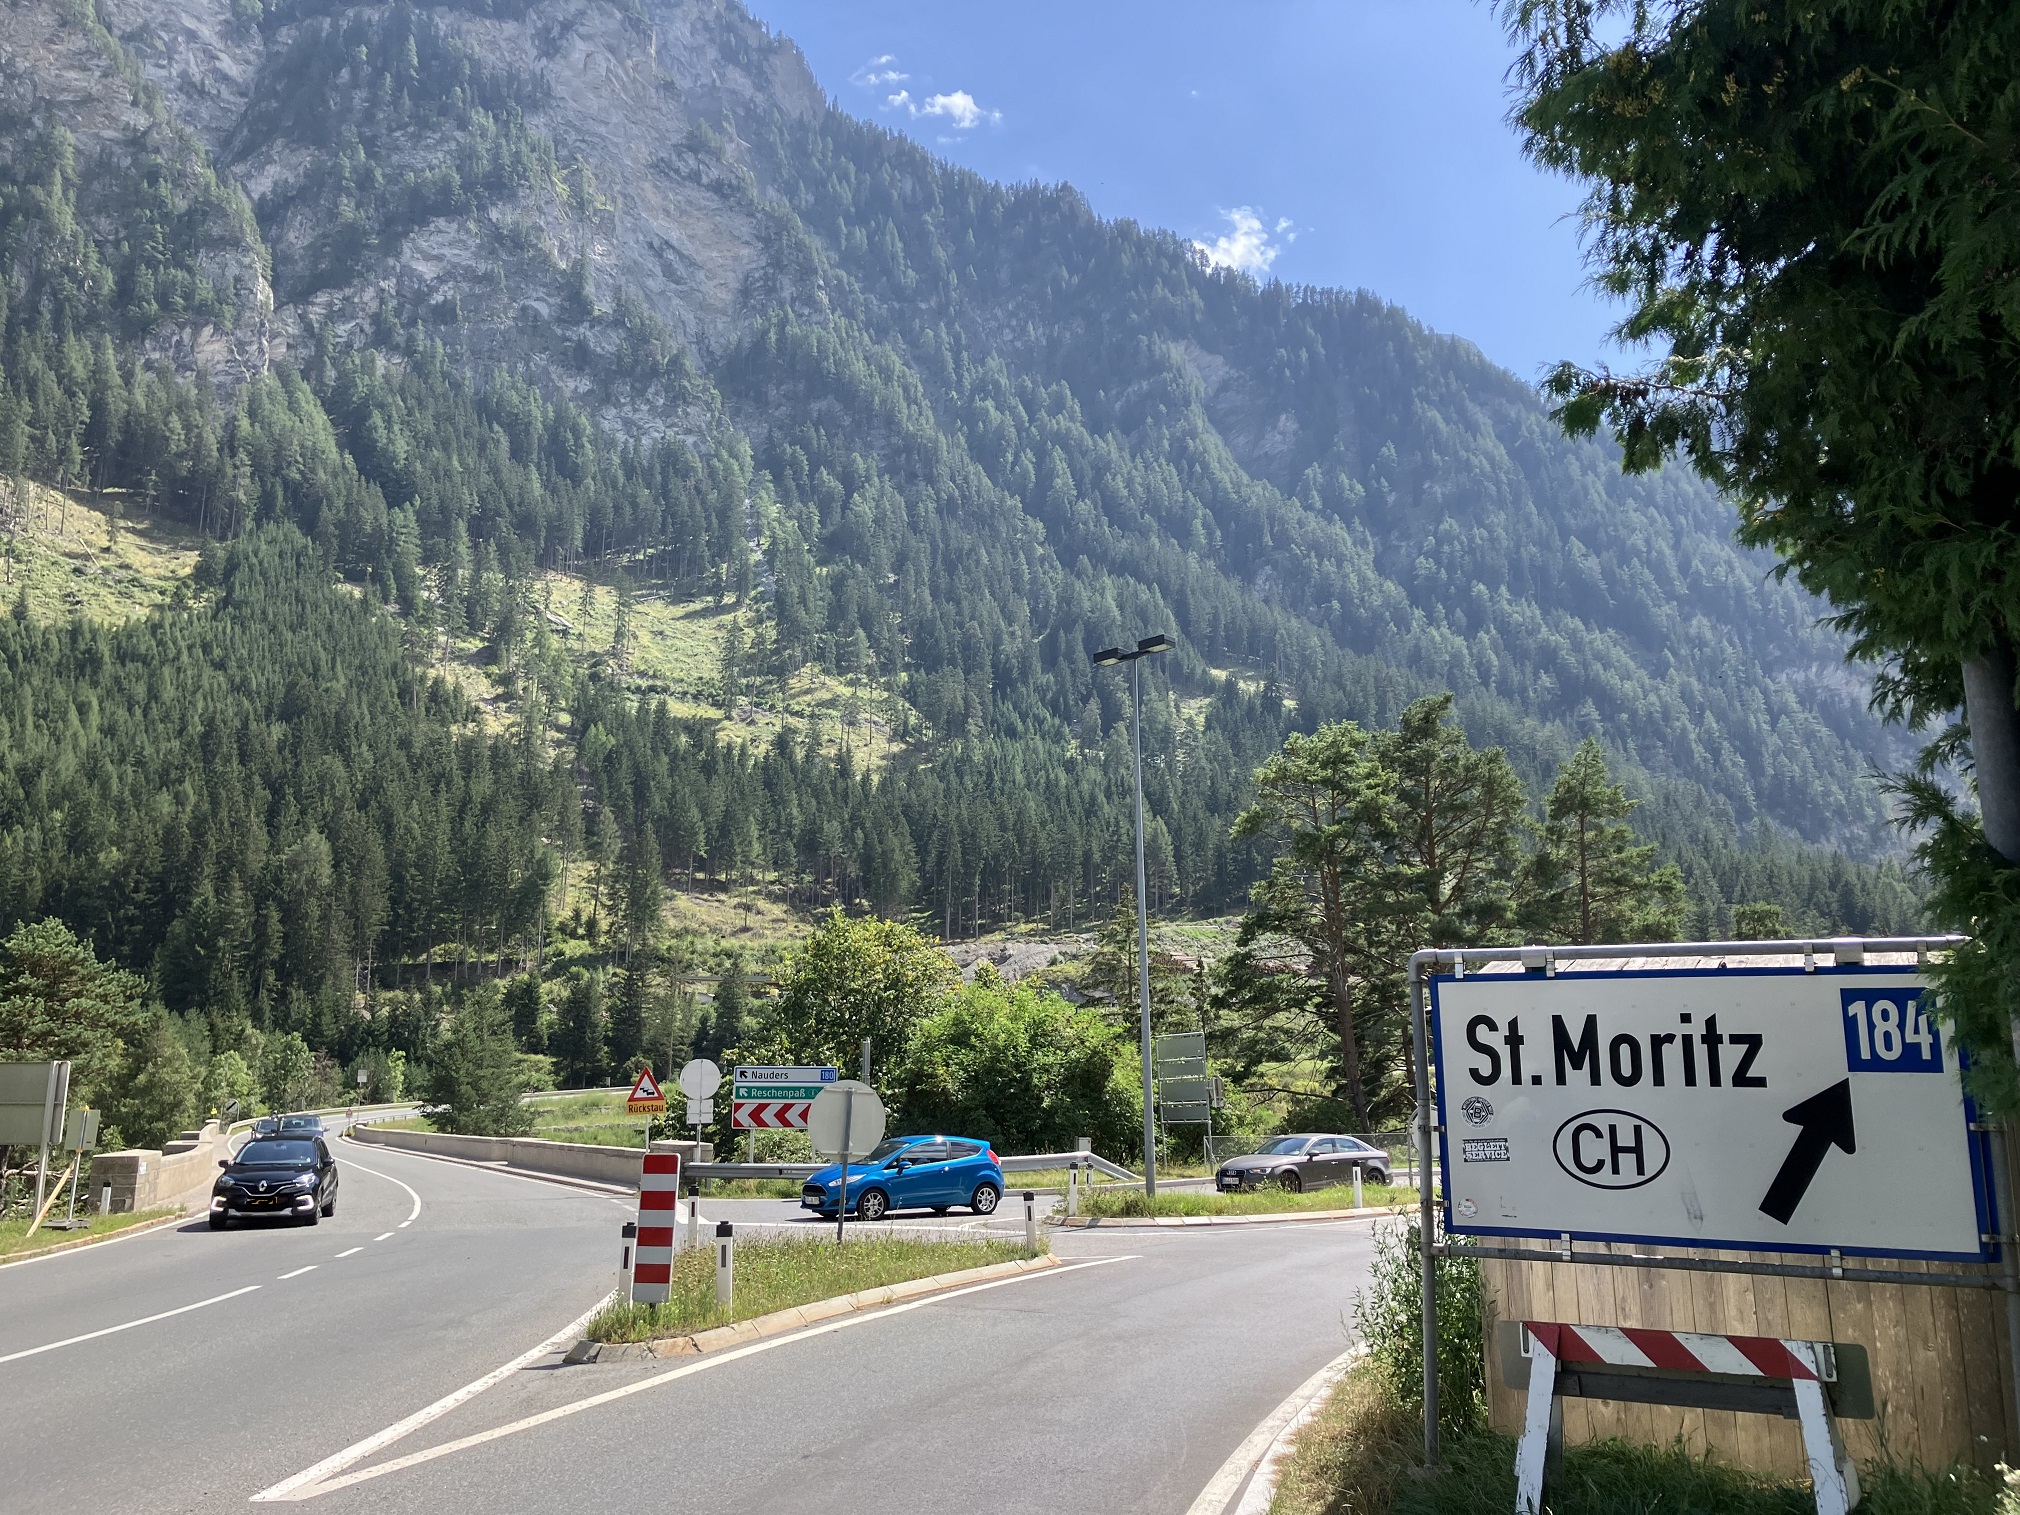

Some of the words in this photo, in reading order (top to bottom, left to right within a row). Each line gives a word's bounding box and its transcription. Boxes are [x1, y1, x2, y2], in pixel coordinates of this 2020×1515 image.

[1848, 999, 1934, 1061] 184
[751, 1070, 789, 1080] Nauders
[821, 1070, 834, 1080] 180
[751, 1088, 806, 1099] Reschenpaß
[628, 1103, 664, 1113] Rückstau
[1464, 1141, 1506, 1151] BEGLEIT
[1571, 1122, 1646, 1176] CH
[1465, 1150, 1508, 1159] SERVICE
